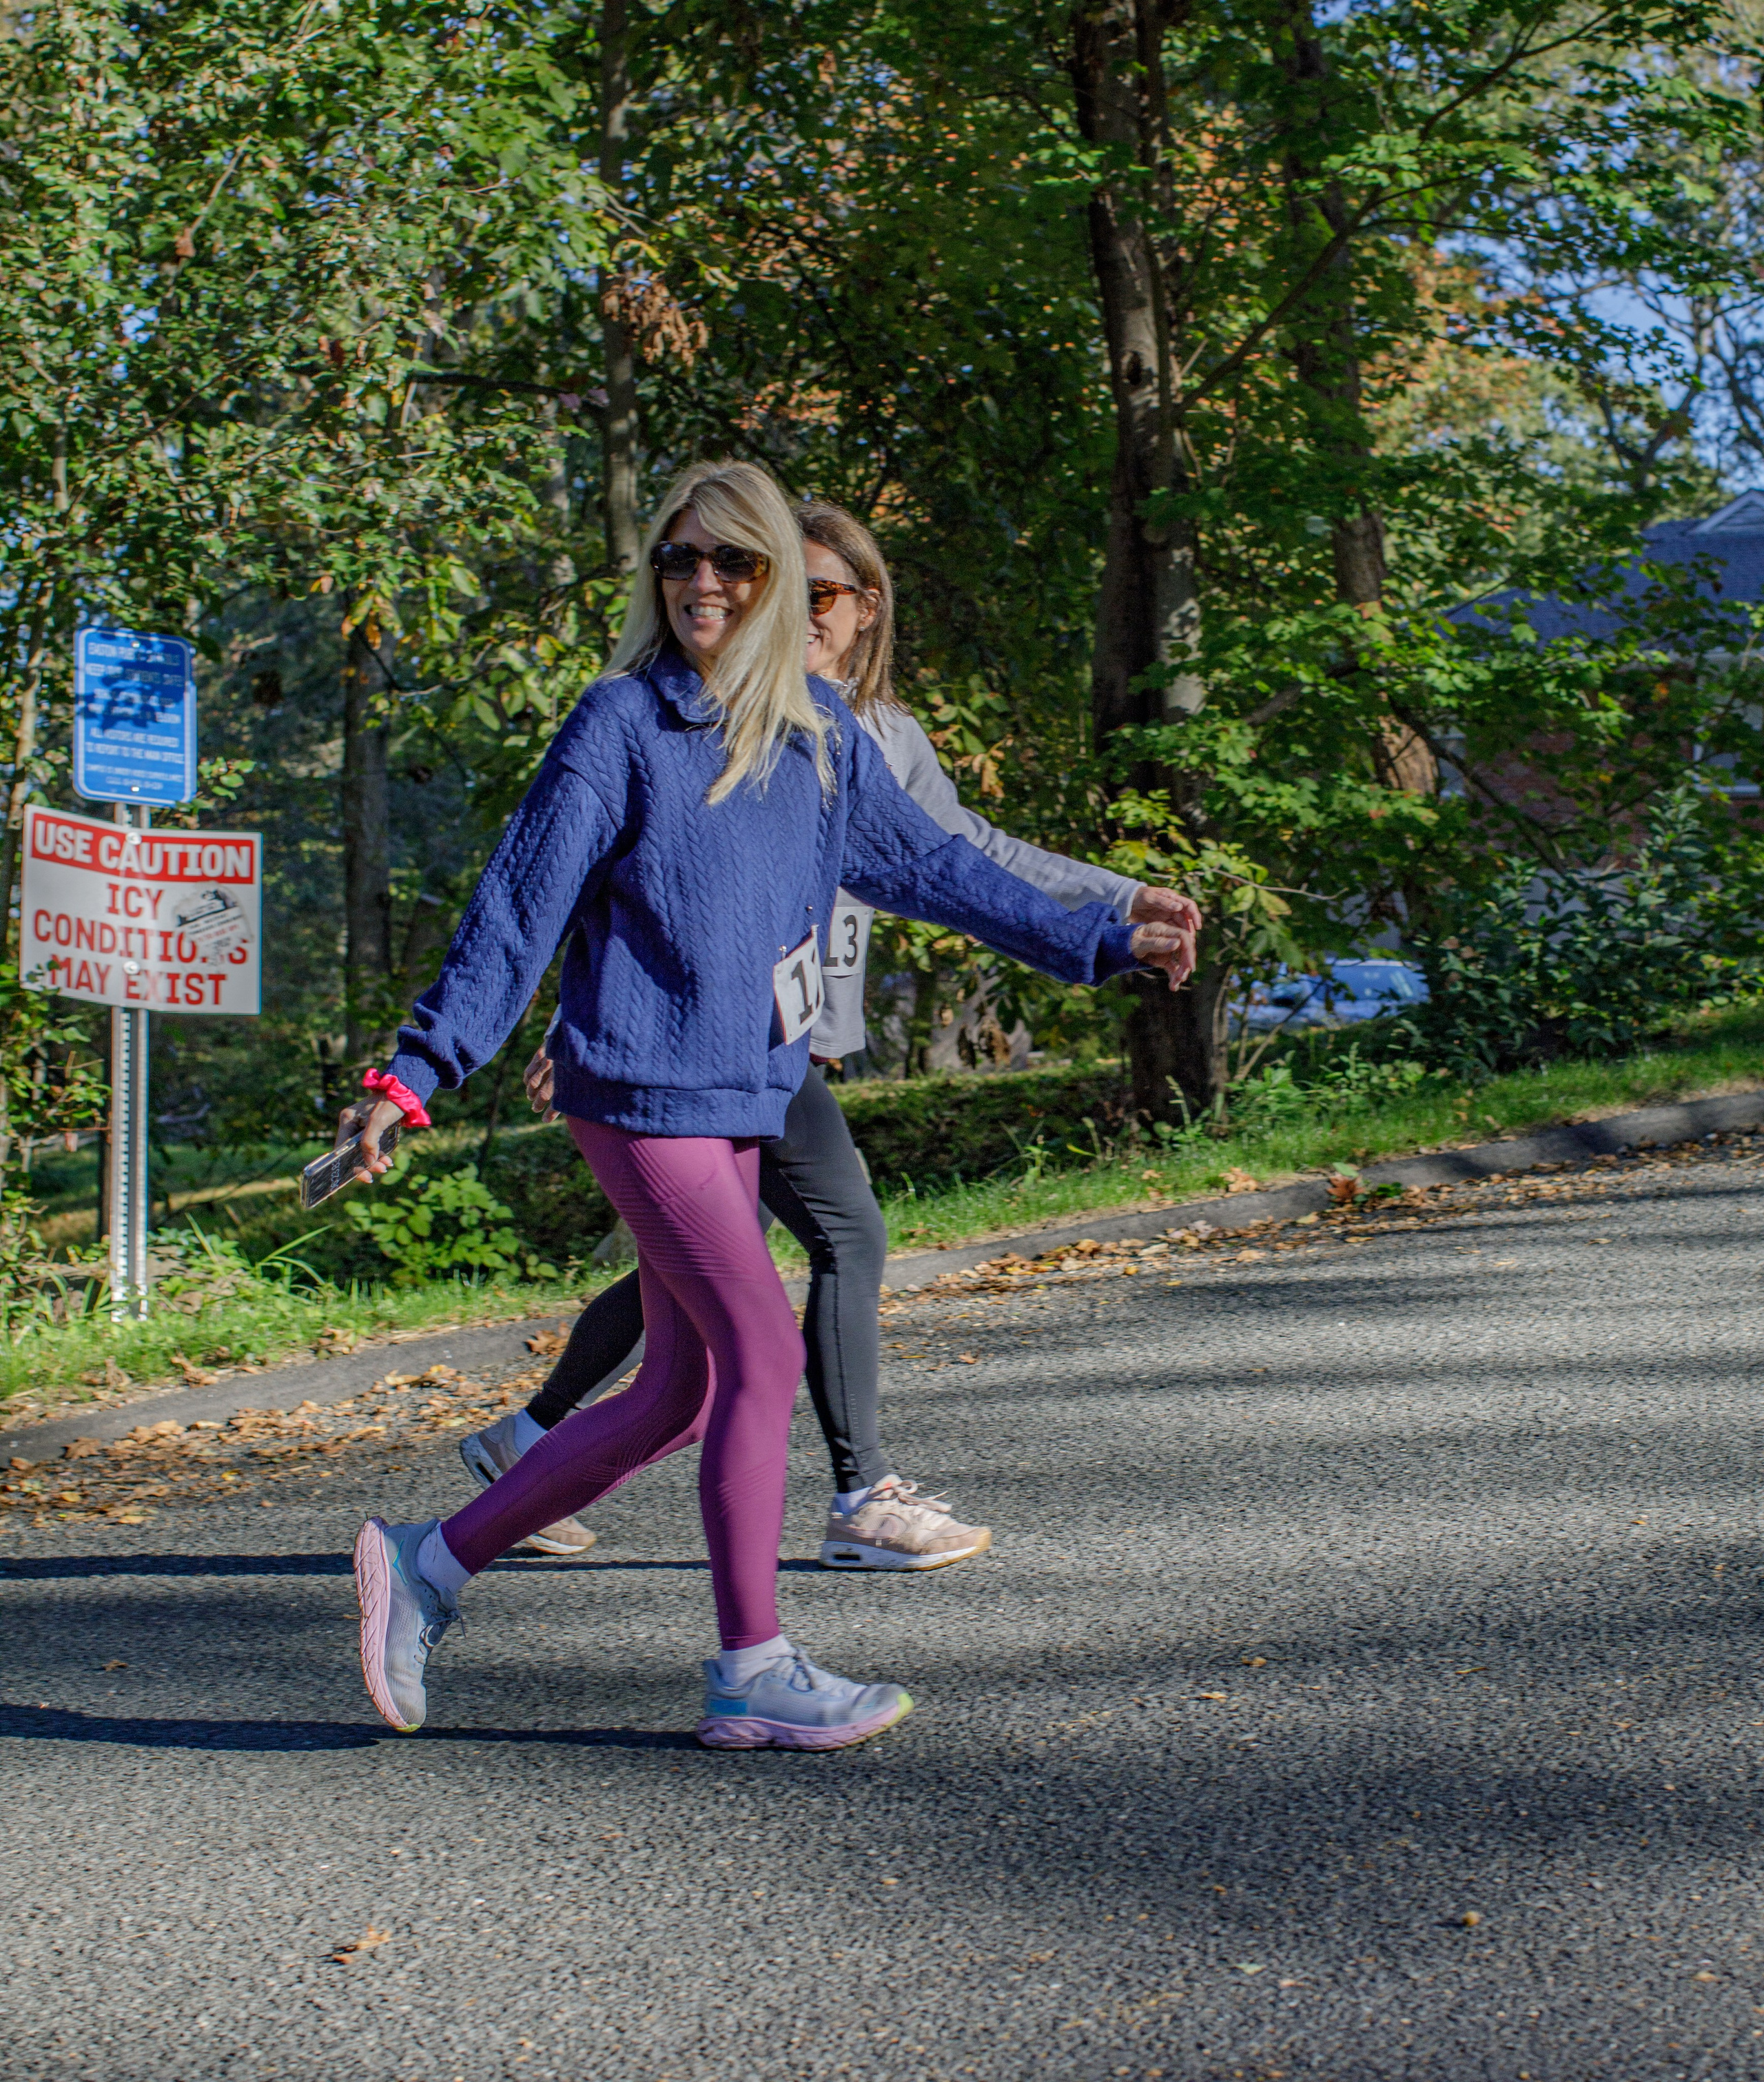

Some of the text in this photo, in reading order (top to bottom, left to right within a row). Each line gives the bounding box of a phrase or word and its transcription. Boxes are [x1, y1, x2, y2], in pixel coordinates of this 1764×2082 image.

[34, 819, 251, 878] USE CAUTION
[107, 883, 165, 920] ICY
[34, 908, 248, 964] CONDITIOS
[50, 954, 112, 995] MAY
[124, 968, 228, 1006] EXIST
